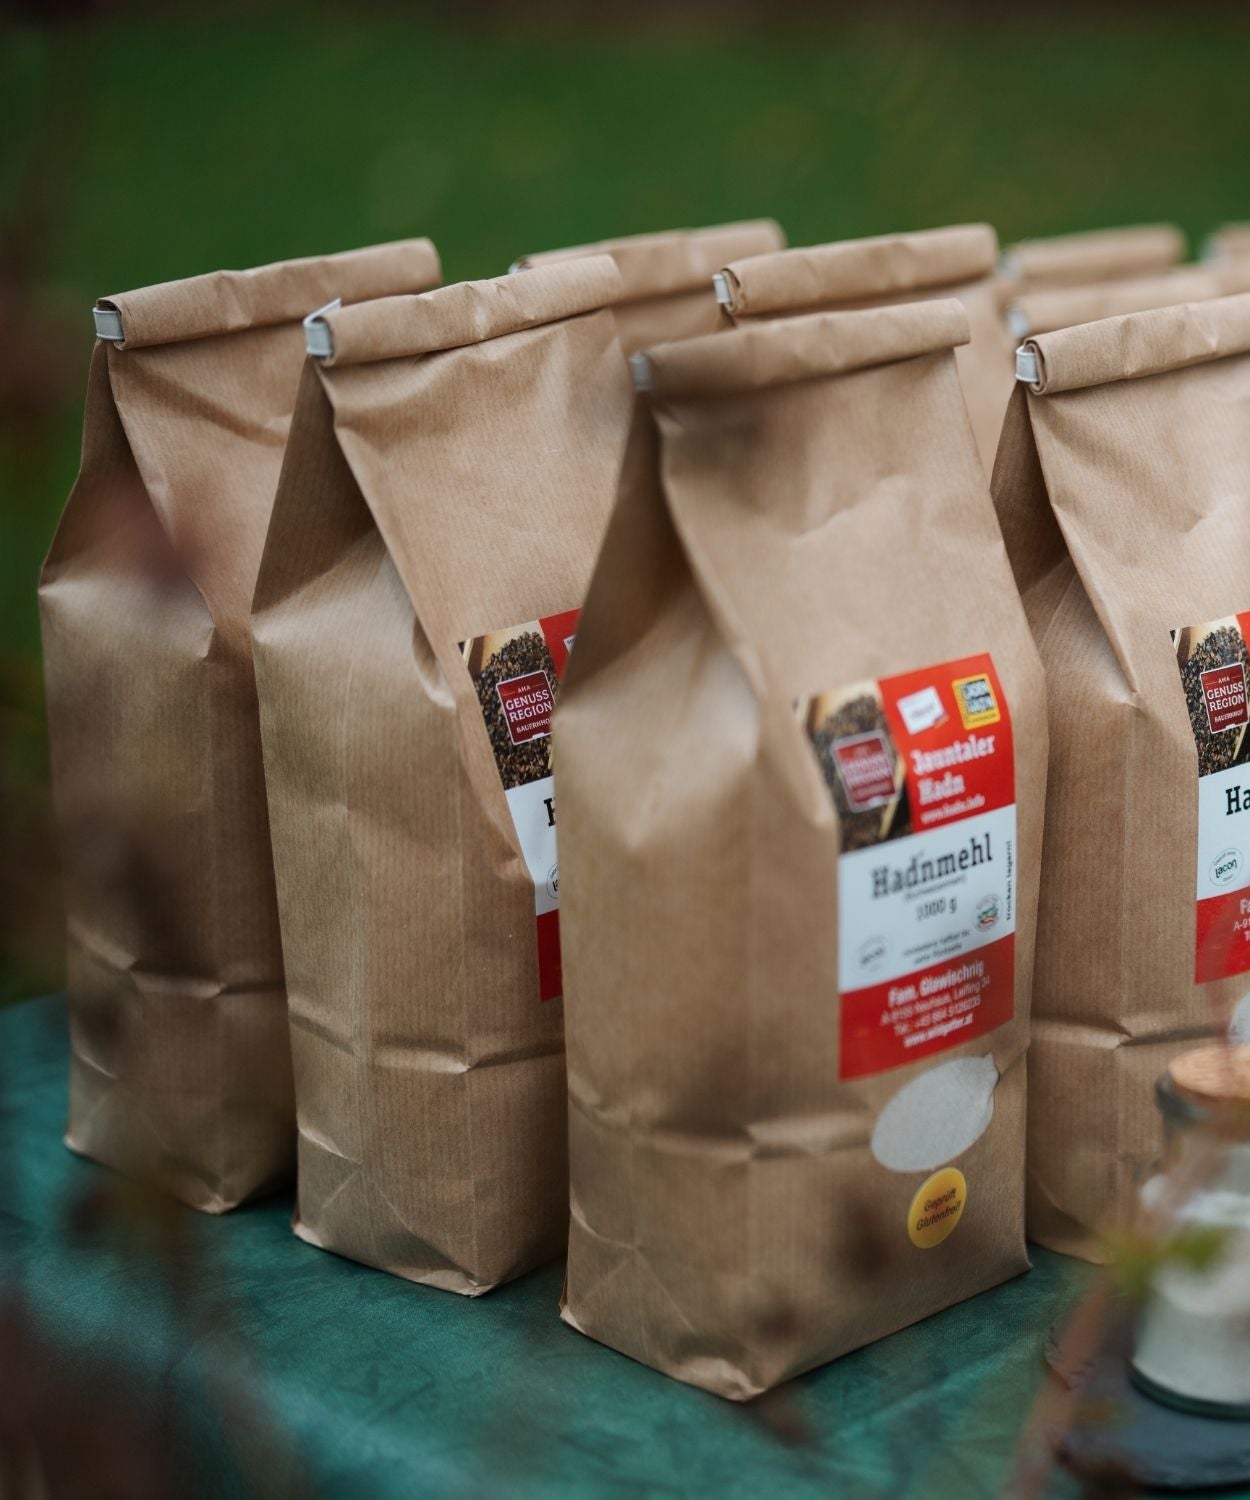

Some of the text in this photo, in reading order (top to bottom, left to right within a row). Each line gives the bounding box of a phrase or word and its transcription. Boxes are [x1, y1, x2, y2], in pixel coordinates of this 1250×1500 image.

[517, 685, 531, 694] AMA
[1207, 682, 1243, 700] GENUSS
[1219, 676, 1231, 684] AMA
[505, 689, 550, 711] GENUSS
[1209, 693, 1245, 712] REGION
[509, 701, 553, 723] REGION
[516, 717, 552, 734] BAUERNHO
[910, 734, 995, 775] Jauntaler
[918, 771, 966, 806] Hadn
[916, 900, 945, 921] 1000
[950, 897, 957, 914] g
[887, 985, 919, 1009] Fam.
